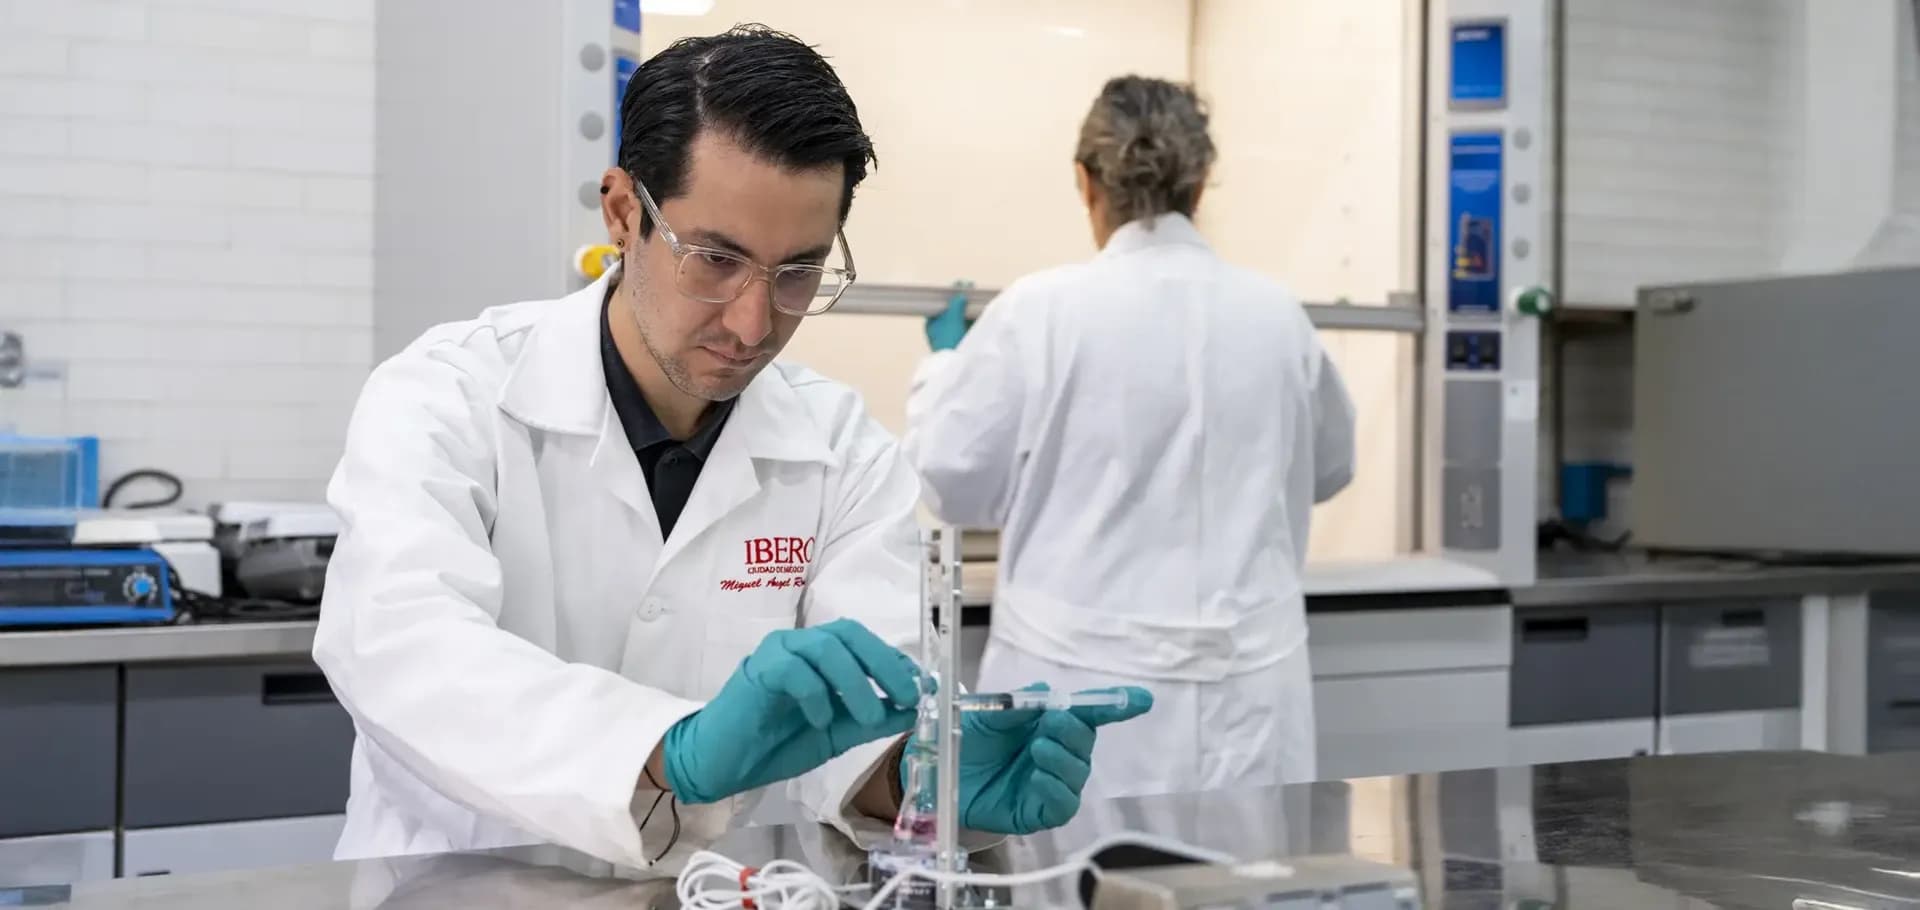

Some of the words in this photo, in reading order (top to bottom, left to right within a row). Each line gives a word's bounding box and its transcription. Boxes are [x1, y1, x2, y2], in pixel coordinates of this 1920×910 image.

[744, 536, 815, 565] IBERO
[747, 566, 775, 575] CIUDAD
[720, 578, 762, 592] Miguel
